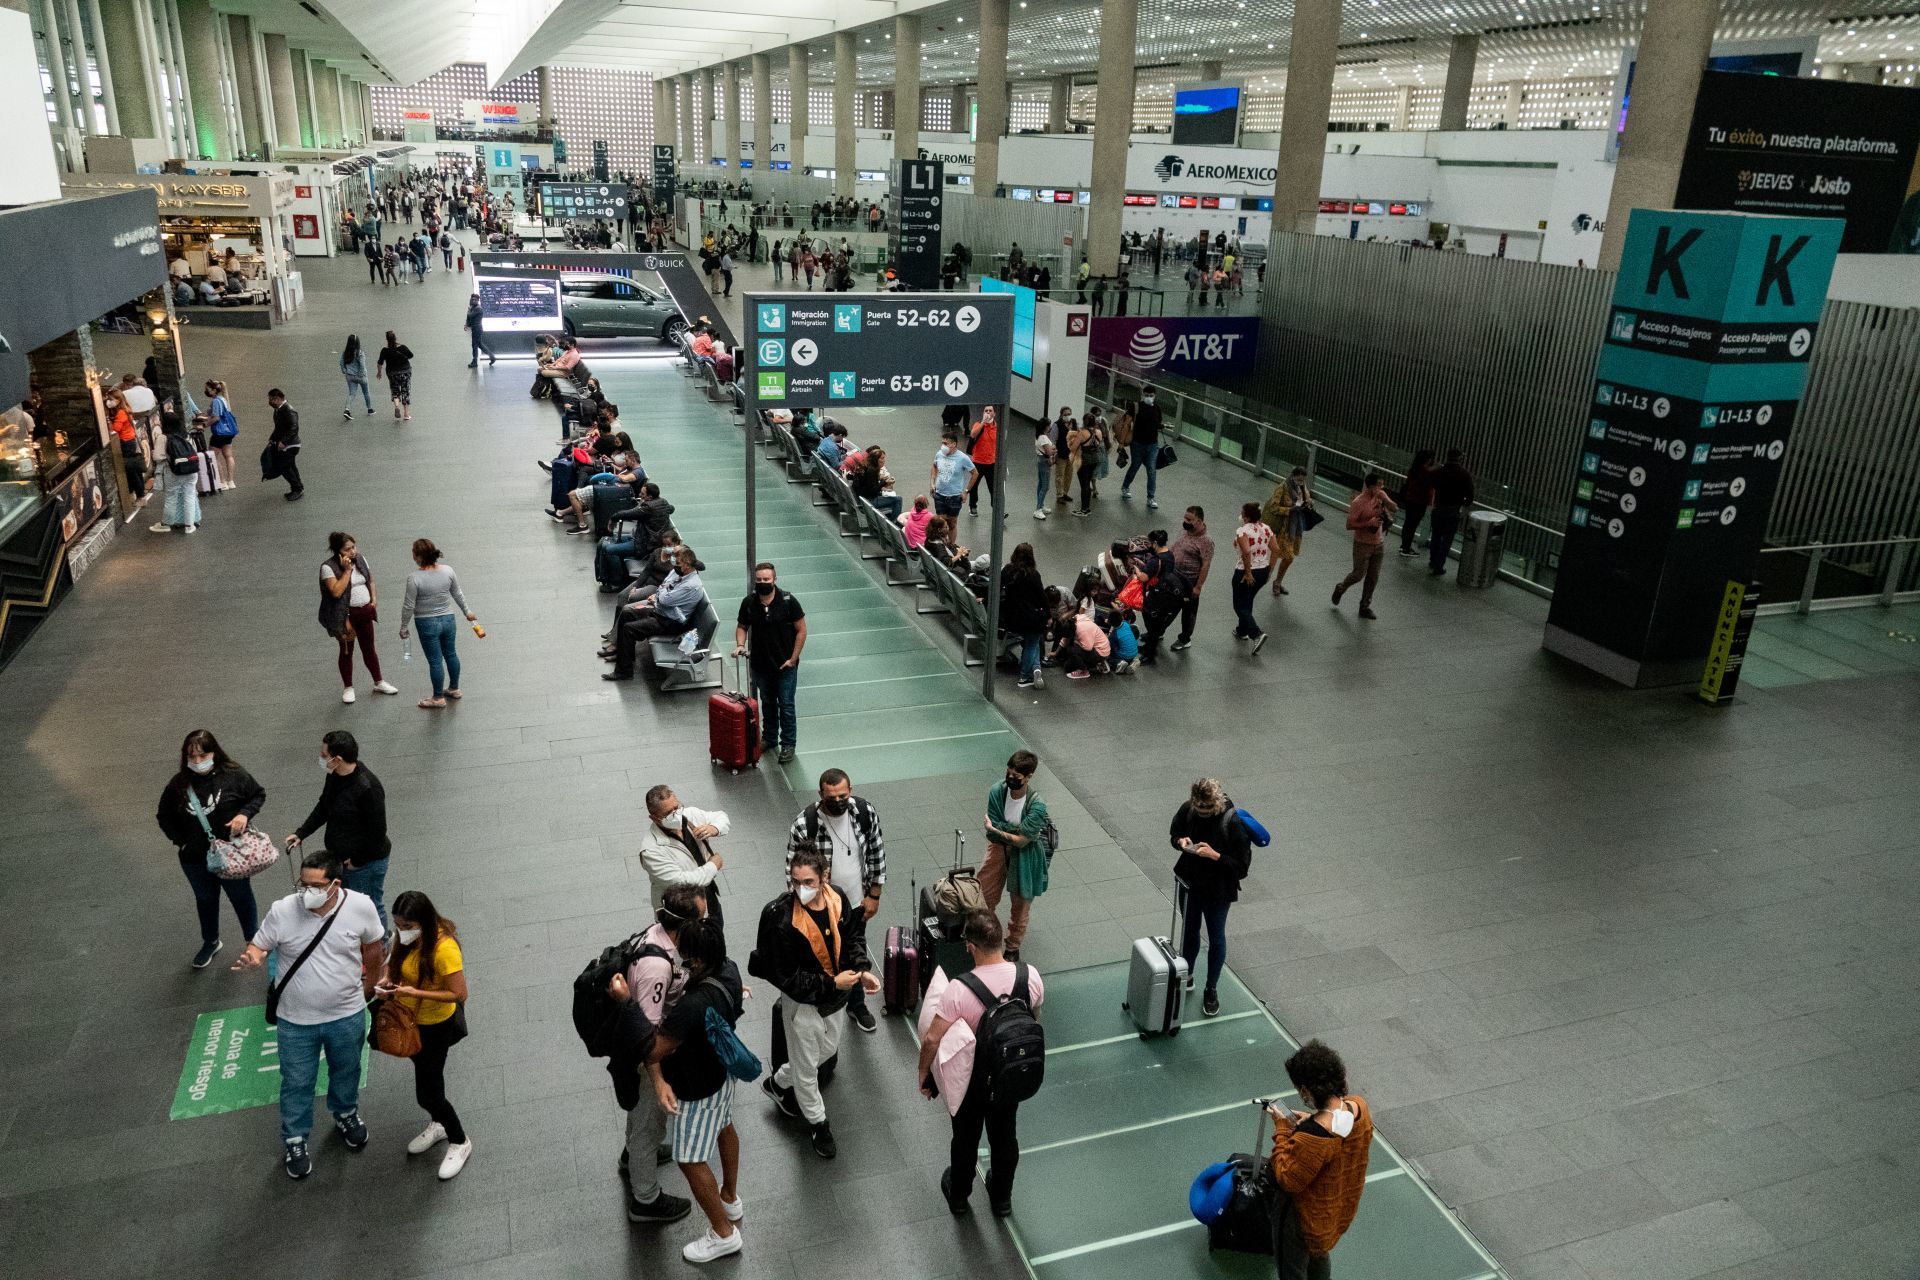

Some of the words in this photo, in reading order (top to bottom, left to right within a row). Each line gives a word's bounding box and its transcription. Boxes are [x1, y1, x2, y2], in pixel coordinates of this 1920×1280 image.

[481, 104, 518, 115] WINGS
[595, 142, 606, 151] L3
[1709, 127, 1726, 143] Tu
[1729, 128, 1767, 148] éxito,
[1770, 133, 1821, 149] nuestra
[1824, 136, 1898, 154] plataforma.
[656, 147, 672, 159] L2
[911, 164, 934, 190] L1
[1749, 173, 1794, 190] JEEVES
[172, 184, 247, 197] KAYSER
[157, 200, 193, 208] ARIS
[659, 259, 684, 268] BUICK
[1645, 226, 1704, 300] K
[1755, 235, 1812, 306] K
[791, 310, 829, 320] Migración
[867, 311, 891, 319] Puerta
[897, 309, 950, 327] 52-62
[1639, 320, 1671, 334] Acceso
[1671, 325, 1713, 341] Pasajeros
[1637, 333, 1668, 346] Passenger
[1668, 338, 1690, 348] access
[1721, 333, 1750, 343] Acceso
[1751, 334, 1788, 344] Pasajeros
[1170, 334, 1239, 361] AT&T
[1719, 346, 1747, 355] Passenger
[1747, 346, 1767, 354] access
[767, 376, 777, 385] T1
[791, 377, 824, 386] Aerotrén
[861, 378, 886, 386] Puerta
[890, 374, 939, 392] 63-81
[1614, 391, 1649, 411] L1-L3
[1719, 409, 1752, 424] L1-L3
[1654, 437, 1667, 453] M
[1753, 444, 1766, 457] M
[652, 982, 664, 1004] 3
[203, 1018, 225, 1056] menor
[226, 1028, 249, 1061] Zona
[221, 1062, 241, 1080] de
[188, 1059, 217, 1101] riesgo
